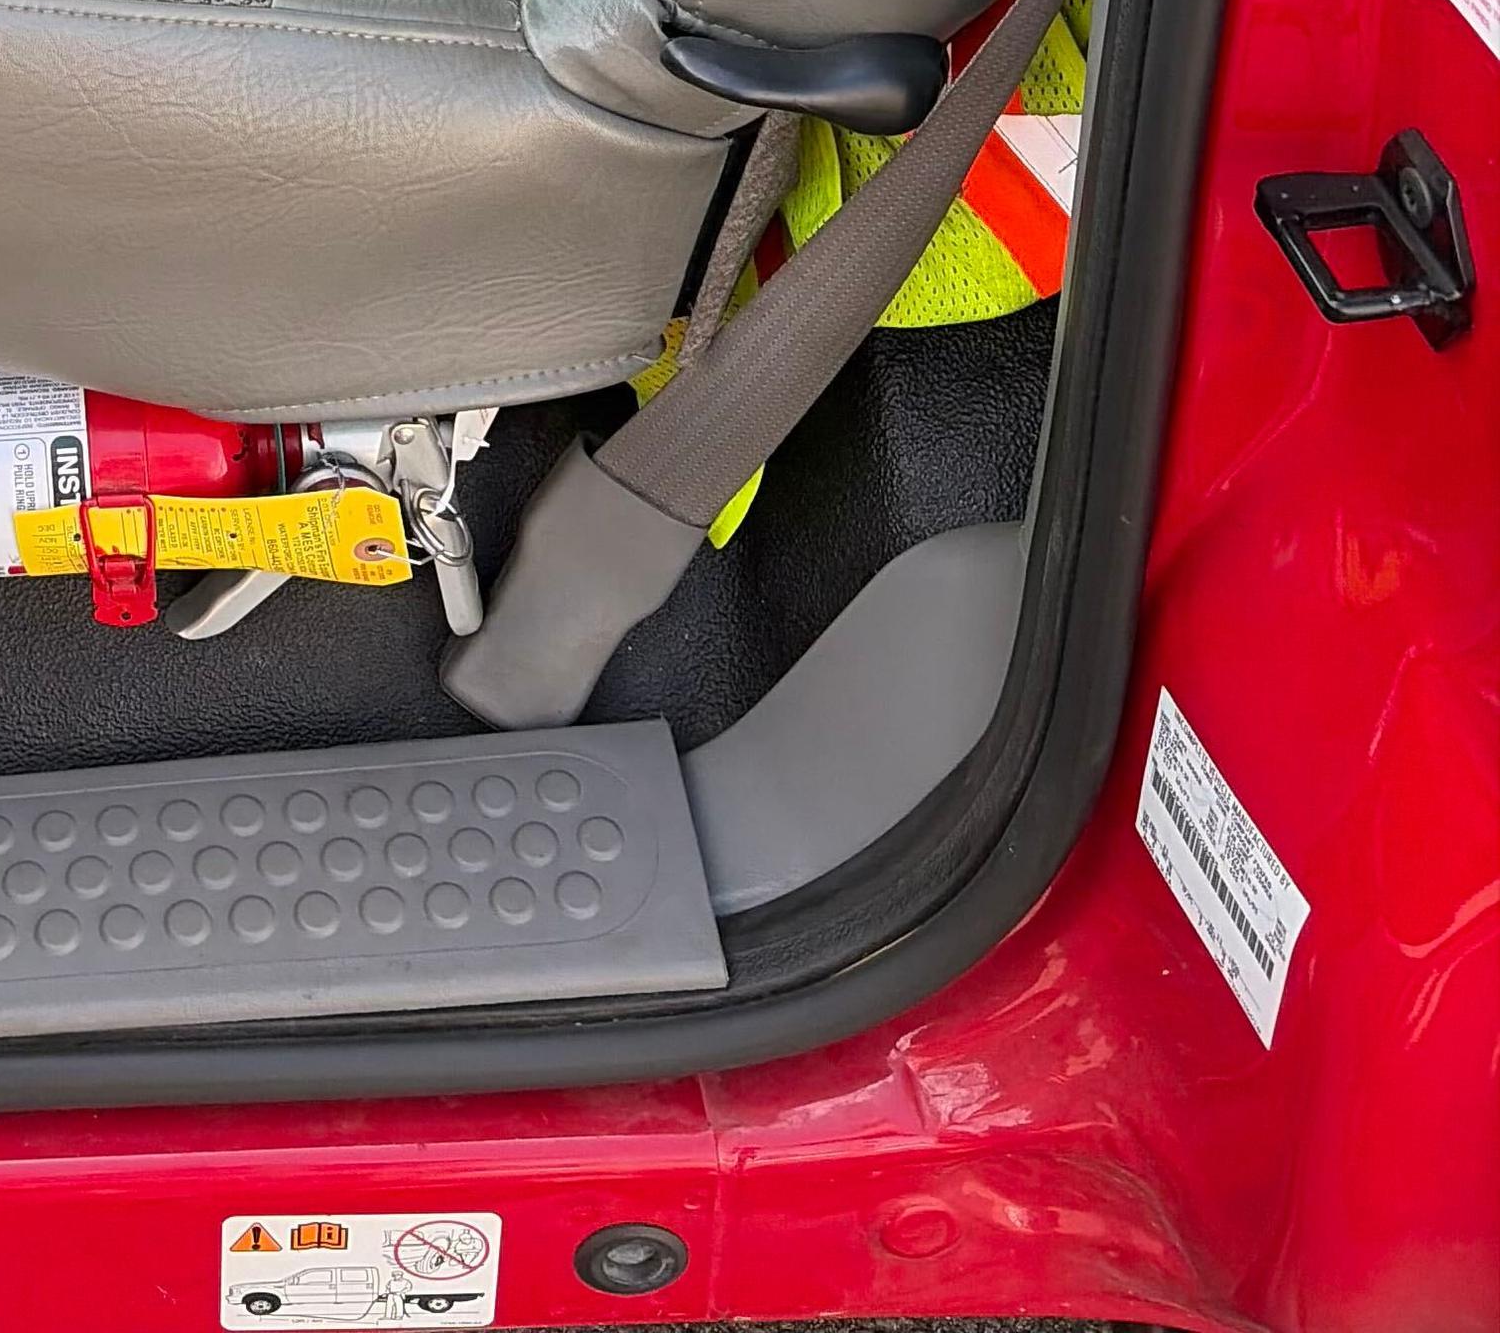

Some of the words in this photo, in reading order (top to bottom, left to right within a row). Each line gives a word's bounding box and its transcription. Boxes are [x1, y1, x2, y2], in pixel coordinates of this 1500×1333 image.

[13, 464, 24, 488] PULL
[24, 464, 35, 487] HOLD
[307, 506, 322, 550] Shipman's
[301, 532, 313, 552] MES
[1231, 797, 1280, 878] MANUFACTURED
